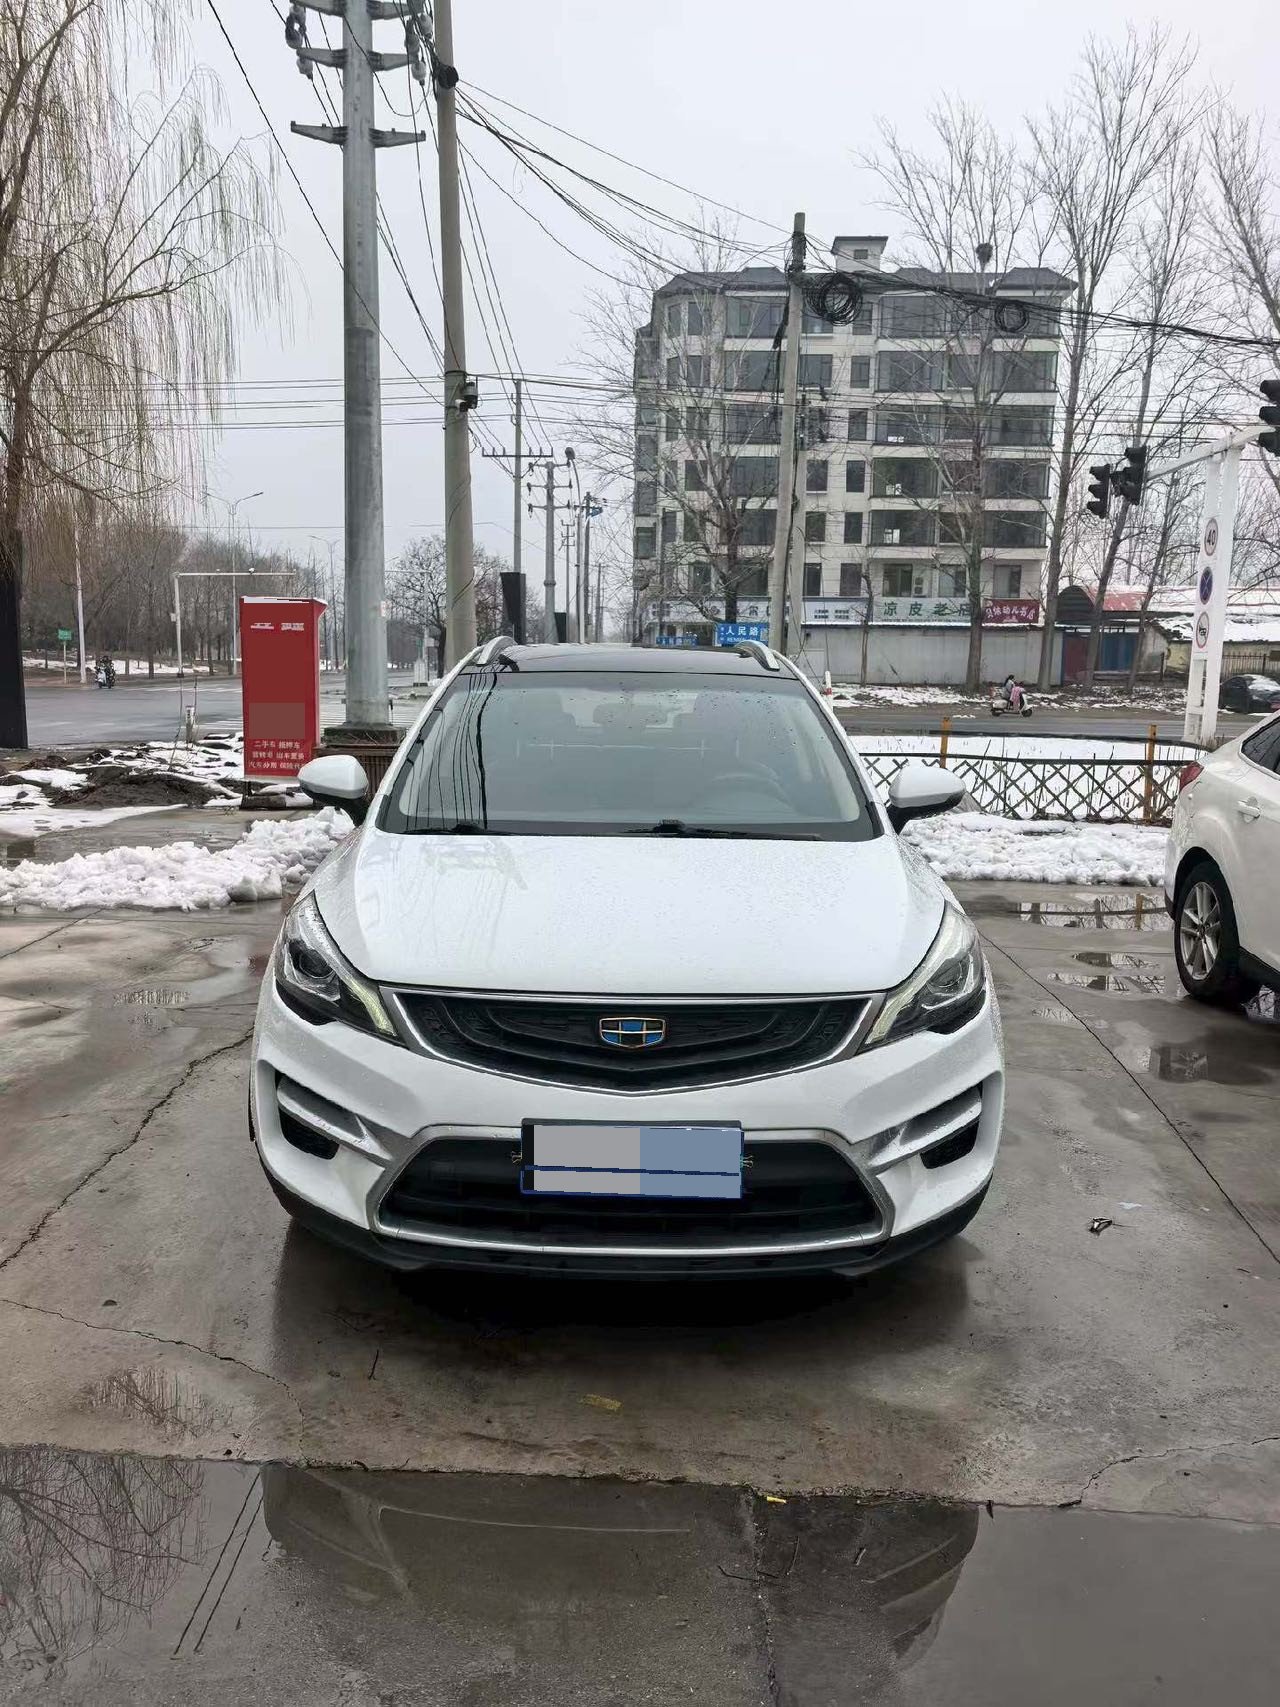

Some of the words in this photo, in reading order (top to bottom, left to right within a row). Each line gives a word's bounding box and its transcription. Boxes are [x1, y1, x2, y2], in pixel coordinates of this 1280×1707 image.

[1206, 529, 1216, 546] 40
[725, 625, 758, 636] 人民路
